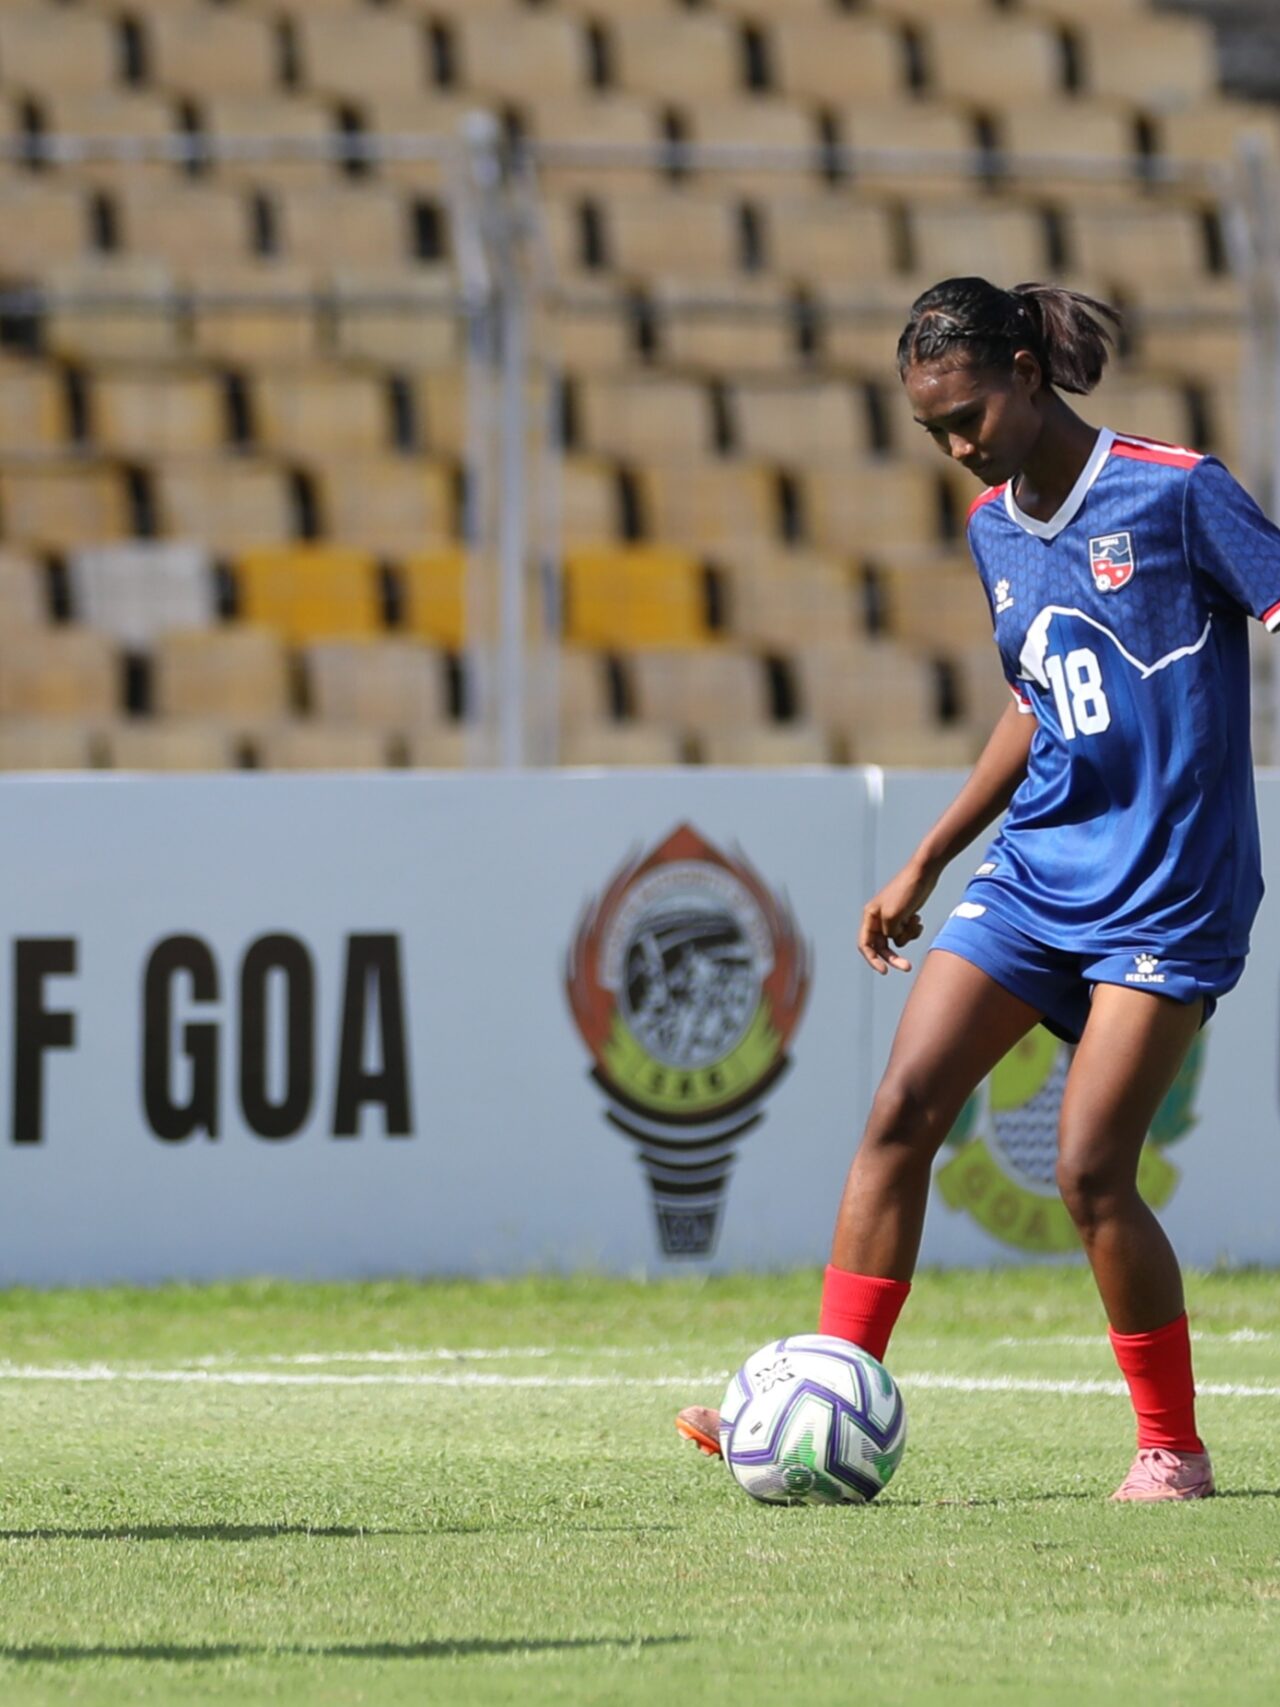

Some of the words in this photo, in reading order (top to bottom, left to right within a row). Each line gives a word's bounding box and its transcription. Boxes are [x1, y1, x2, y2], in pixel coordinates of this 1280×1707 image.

[1045, 647, 1112, 740] 18
[1124, 972, 1167, 984] KELME
[141, 932, 415, 1144] GOA
